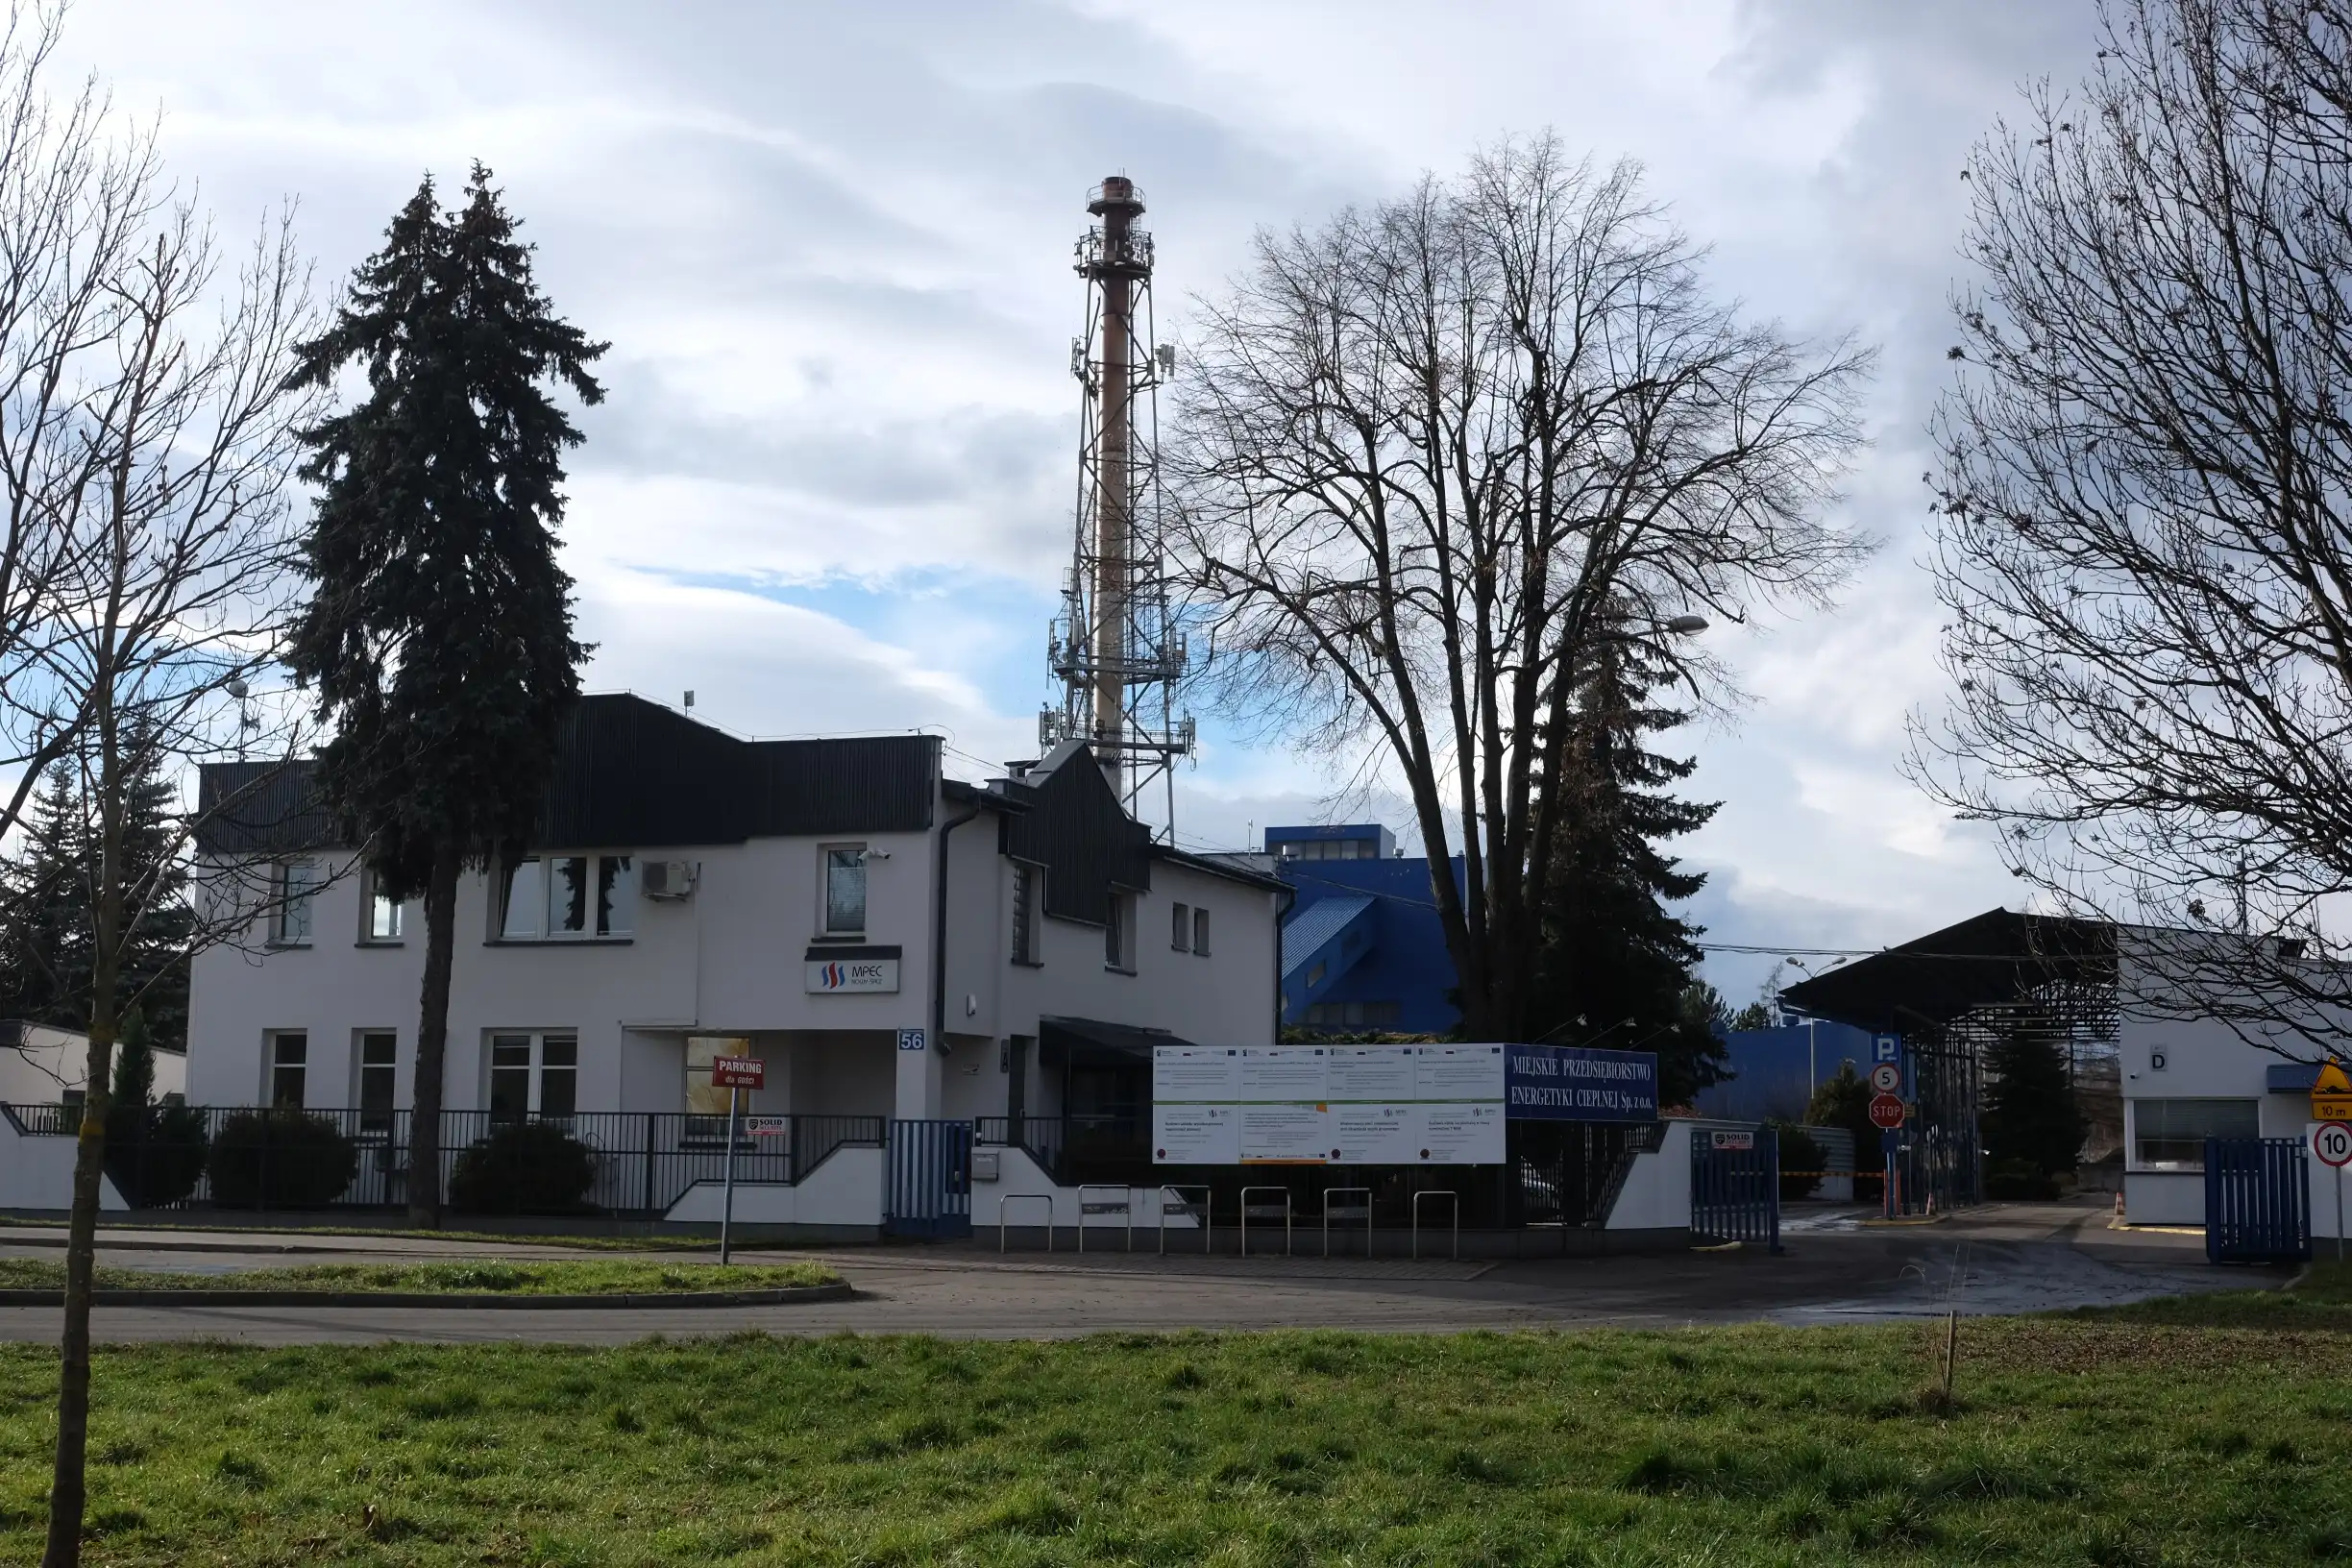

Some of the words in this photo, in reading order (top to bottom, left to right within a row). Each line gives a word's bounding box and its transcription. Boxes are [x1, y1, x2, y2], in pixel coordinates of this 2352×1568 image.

[851, 966, 883, 977] MPEC
[901, 1033, 922, 1049] 56
[1877, 1039, 1895, 1061] P
[719, 1061, 762, 1074] PARKING
[2152, 1054, 2165, 1069] D
[1512, 1056, 1558, 1077] MIEJSKIE
[1563, 1059, 1651, 1083] PRZEDSIĘBIORSTWO
[737, 1076, 755, 1085] GOŚCI
[1882, 1072, 1890, 1085] 5
[1511, 1087, 1573, 1107] ENERGETYKI
[1577, 1089, 1618, 1110] CIEPLNEJ
[1633, 1097, 1639, 1109] z
[1874, 1106, 1900, 1116] STOP
[2322, 1106, 2333, 1116] 10
[2324, 1133, 2346, 1154] 10
